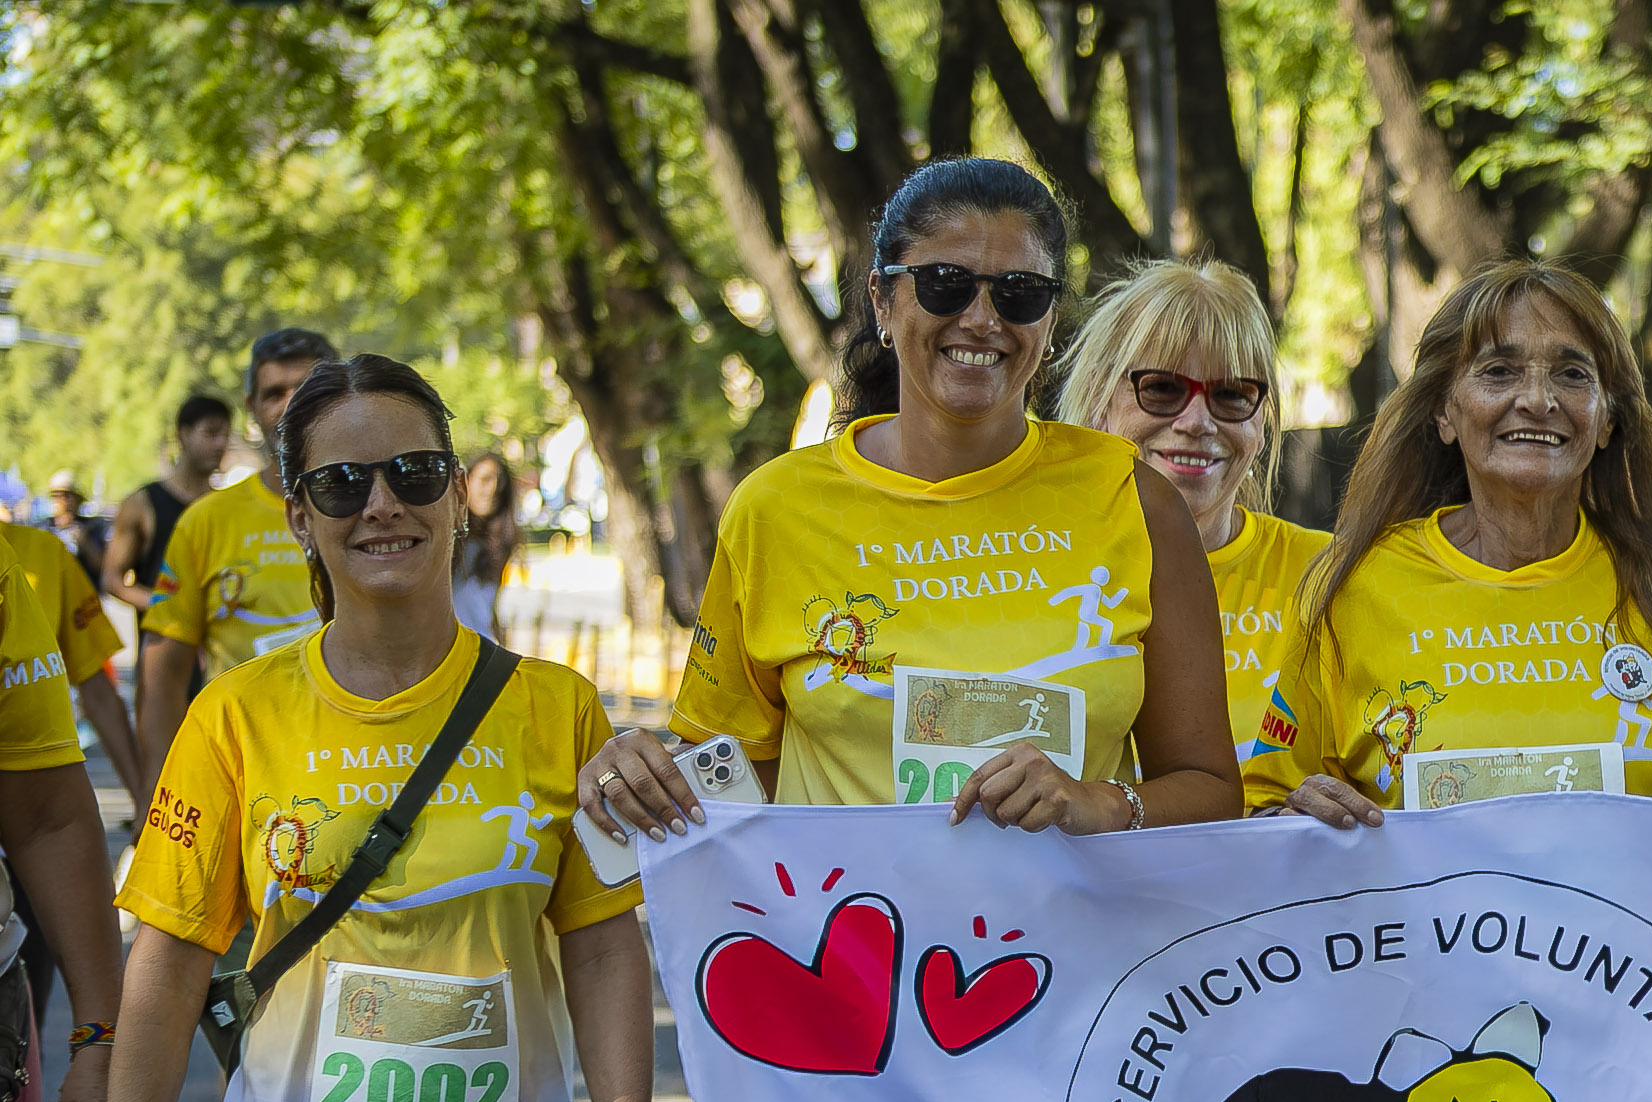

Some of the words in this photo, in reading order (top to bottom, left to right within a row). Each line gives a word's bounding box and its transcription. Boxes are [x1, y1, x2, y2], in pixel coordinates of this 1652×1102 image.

[893, 524, 1071, 565] MARATÓN
[893, 567, 1048, 602] DORADA
[1444, 615, 1617, 649] MARATÓN
[1443, 658, 1592, 687] DORADA
[964, 692, 1007, 703] DORADA
[340, 740, 504, 770] MARÓN
[337, 782, 482, 806] DODA
[1325, 922, 1406, 972] DE
